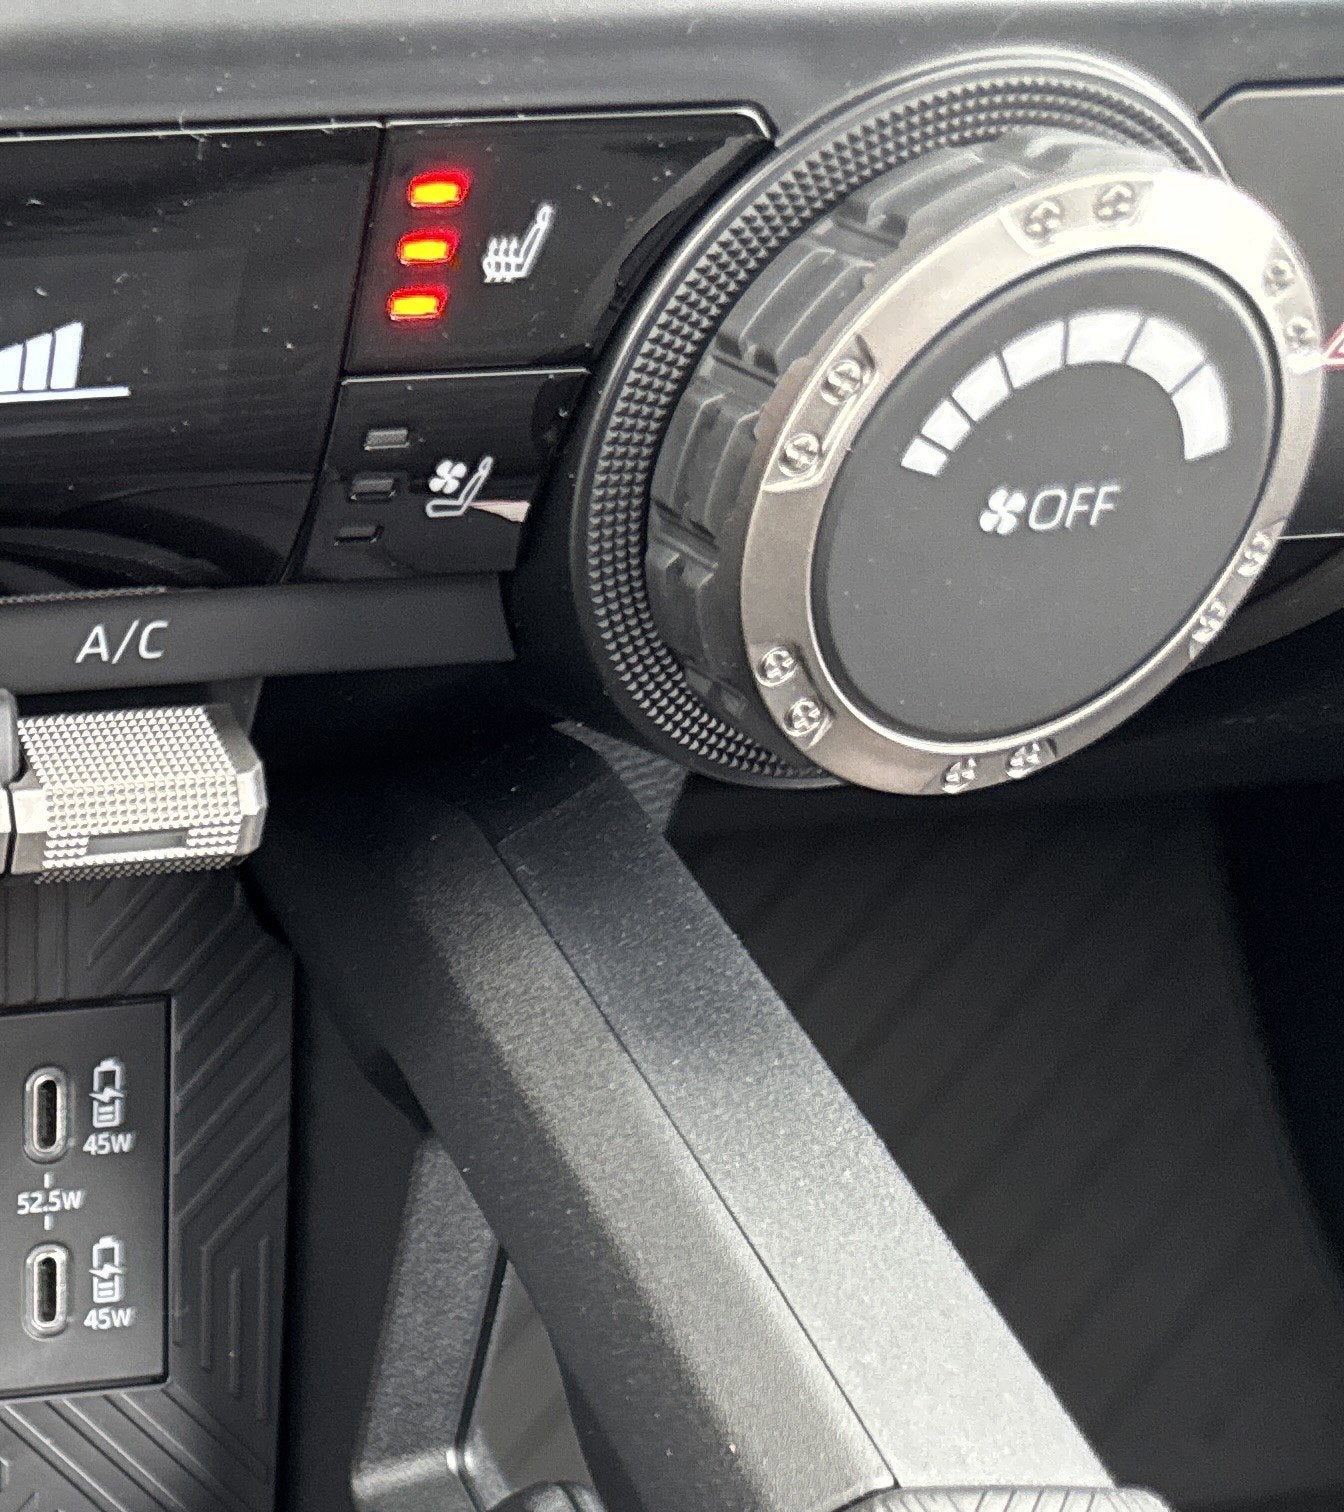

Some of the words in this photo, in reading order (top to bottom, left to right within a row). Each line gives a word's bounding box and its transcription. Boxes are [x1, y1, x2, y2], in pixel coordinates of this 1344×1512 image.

[1028, 483, 1121, 532] OFF
[75, 618, 169, 664] A/C
[83, 1132, 133, 1156] 45W
[17, 1189, 82, 1216] 52.5W
[84, 1306, 133, 1330] 45W
